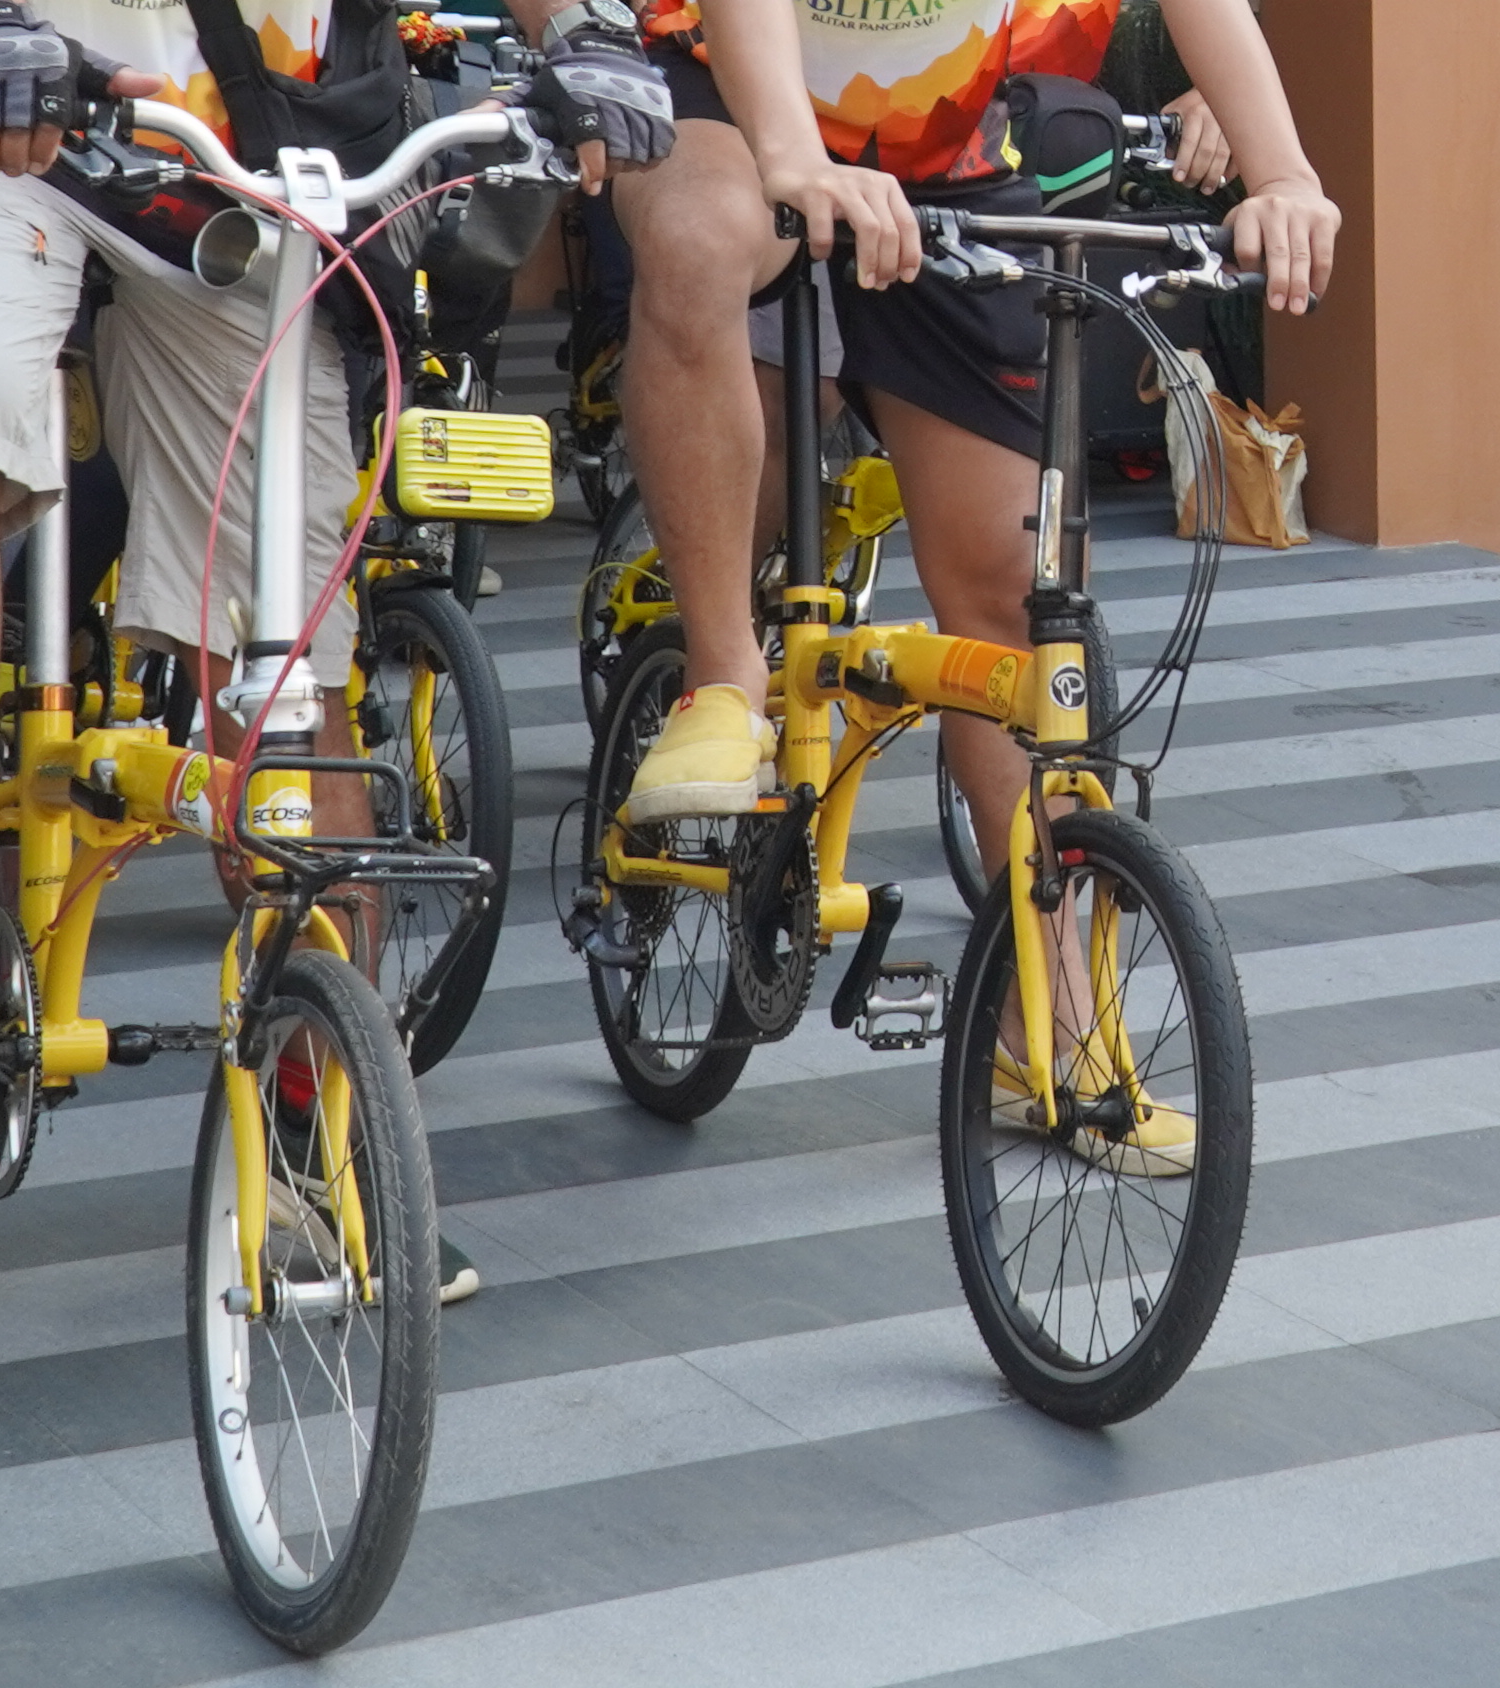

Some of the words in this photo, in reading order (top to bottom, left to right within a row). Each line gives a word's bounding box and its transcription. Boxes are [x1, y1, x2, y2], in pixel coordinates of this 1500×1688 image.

[811, 12, 856, 31] BLITAR
[859, 20, 911, 32] PANCEN
[913, 14, 936, 30] SAE
